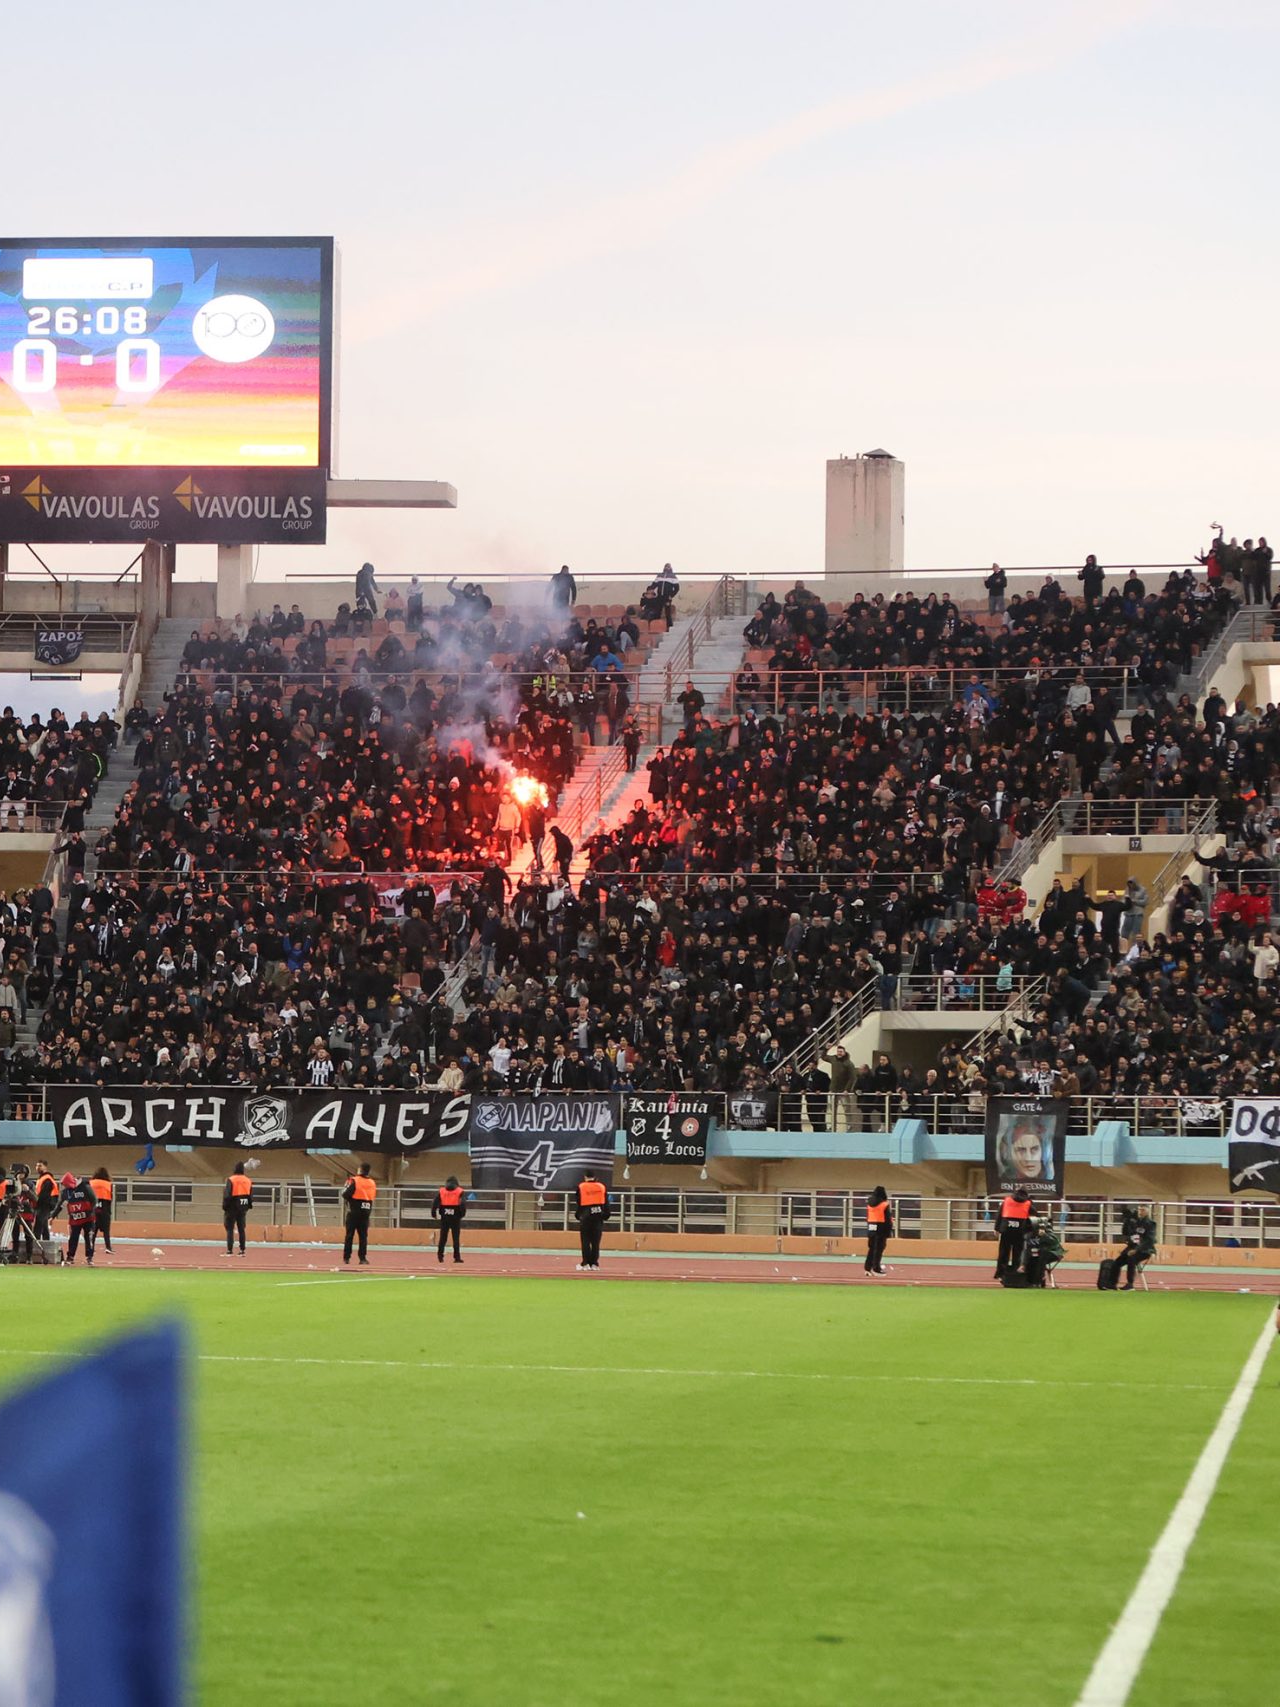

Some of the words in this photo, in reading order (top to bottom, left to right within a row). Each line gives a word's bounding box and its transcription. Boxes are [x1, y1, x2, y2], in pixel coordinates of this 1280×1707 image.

[27, 306, 147, 335] 26:08
[13, 338, 57, 393] 0
[116, 338, 161, 393] 0
[41, 495, 160, 519] VAVOULAS
[193, 495, 313, 519] VAVOULAS
[129, 519, 160, 530] GROUP
[282, 519, 313, 530] GROUP
[1131, 839, 1140, 848] 17
[62, 1096, 227, 1139] ARCH
[1012, 1102, 1035, 1112] GATE
[1036, 1103, 1043, 1111] 4
[655, 1114, 672, 1141] 4
[627, 1142, 660, 1157] Vatos
[665, 1141, 705, 1157] Locos
[514, 1140, 558, 1191] 4
